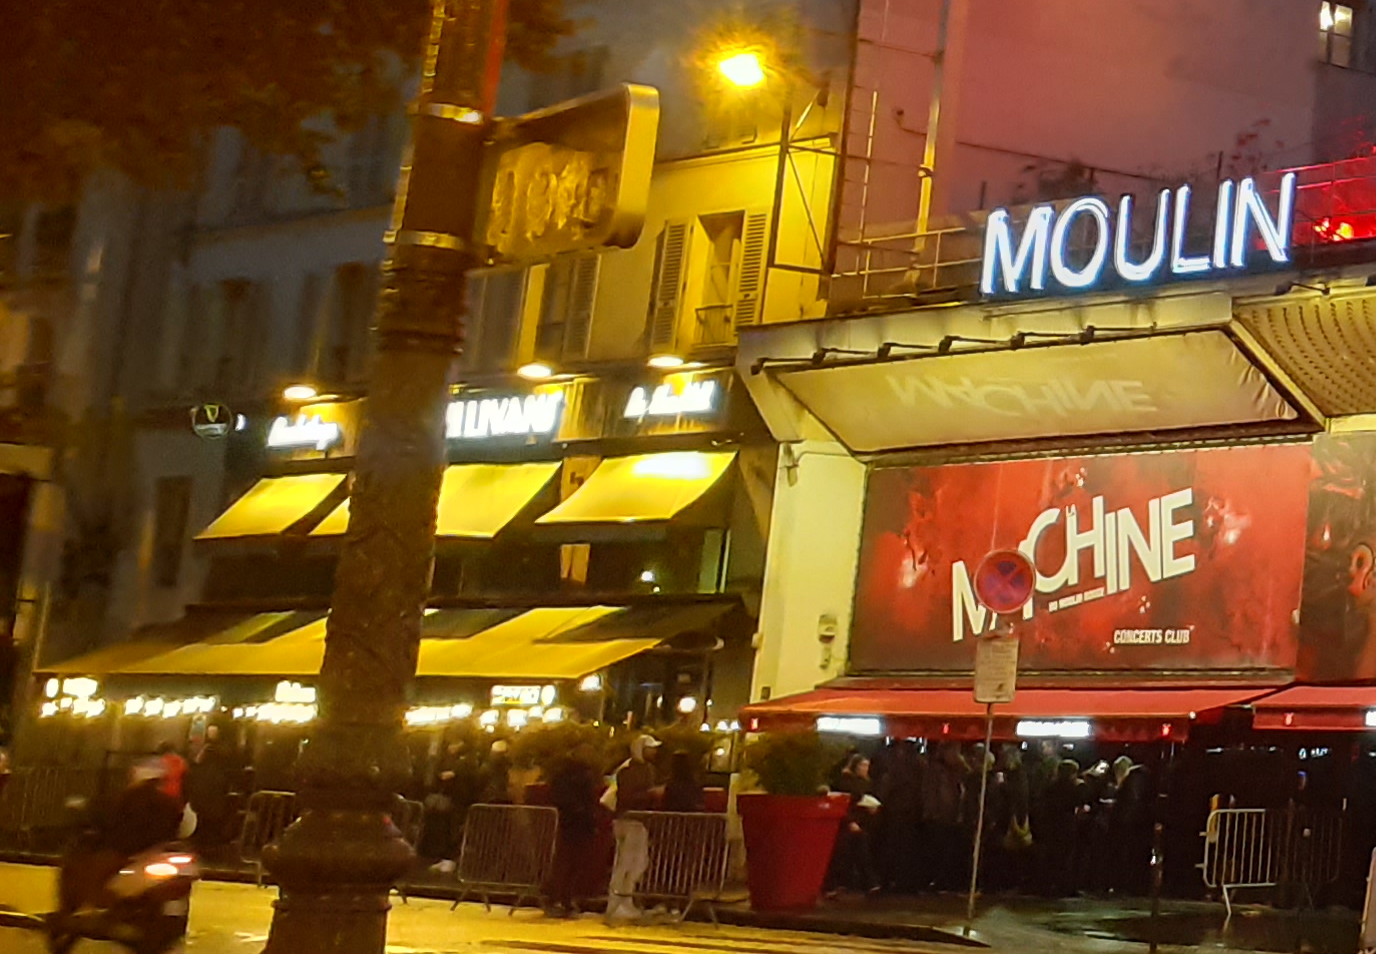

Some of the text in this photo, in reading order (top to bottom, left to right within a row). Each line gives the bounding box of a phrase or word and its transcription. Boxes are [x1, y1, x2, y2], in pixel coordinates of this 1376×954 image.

[980, 170, 1298, 296] MOULIN
[1114, 629, 1190, 644] CONCERTS CLUB
